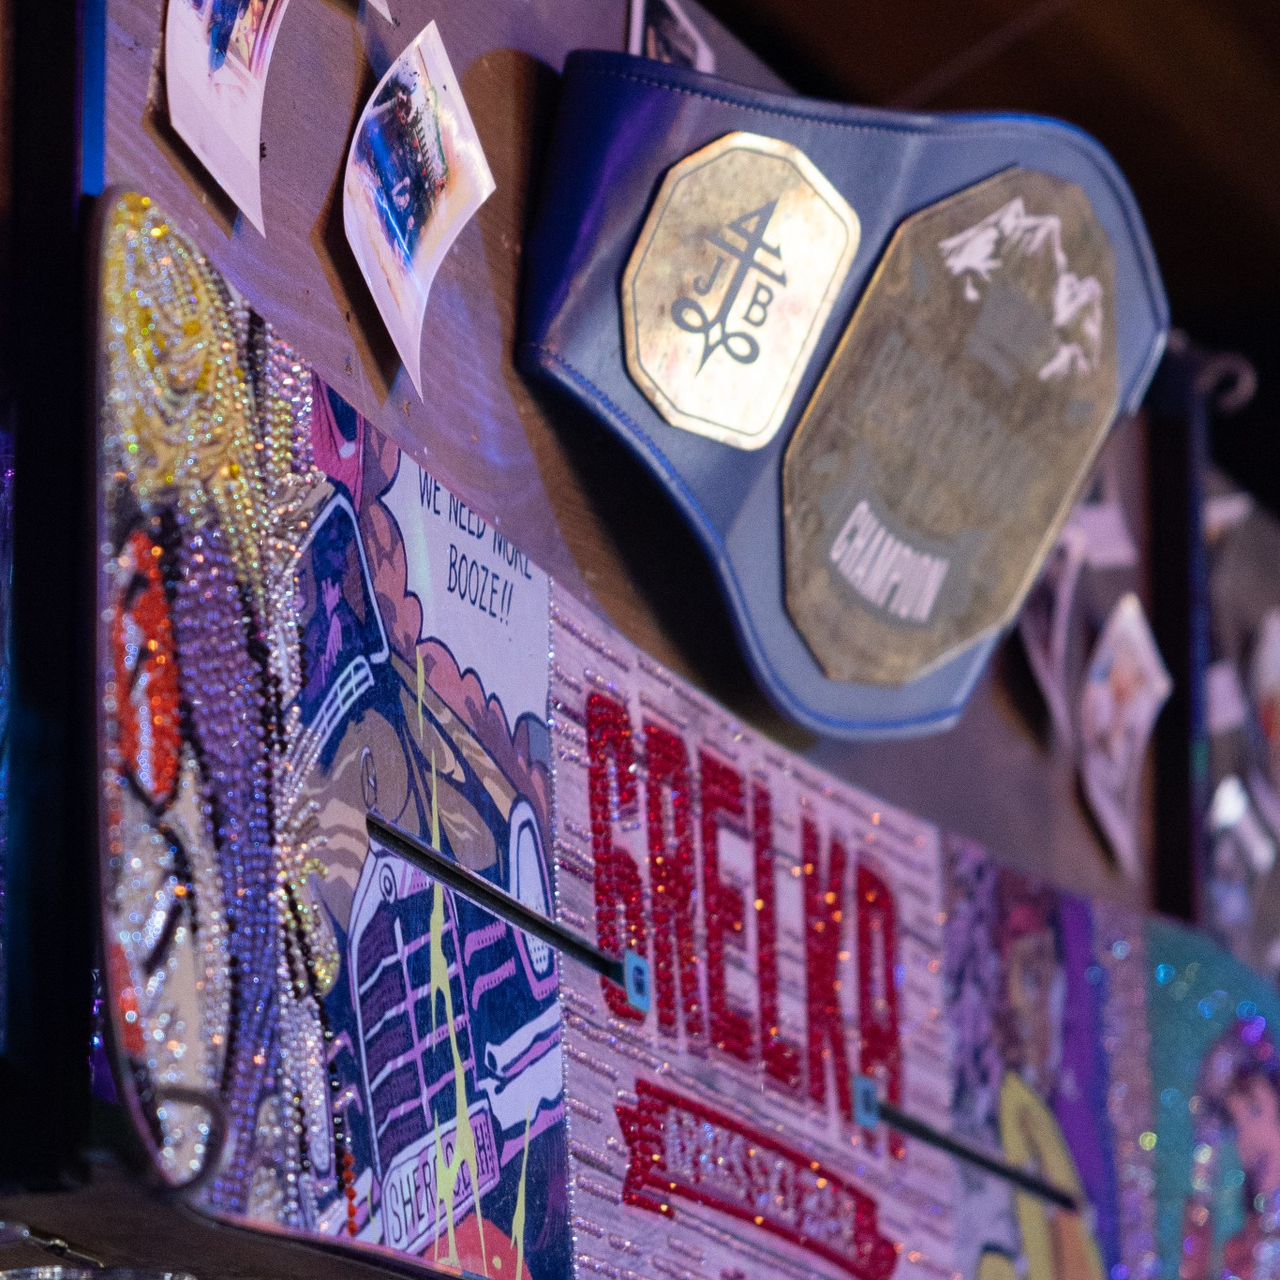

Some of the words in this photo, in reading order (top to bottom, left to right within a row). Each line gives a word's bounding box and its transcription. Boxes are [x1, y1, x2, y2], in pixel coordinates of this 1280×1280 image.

[418, 465, 442, 516] WE
[446, 543, 514, 626] BOOZE!!
[829, 499, 951, 621] CHAMPION
[586, 691, 905, 1159] GRELKA
